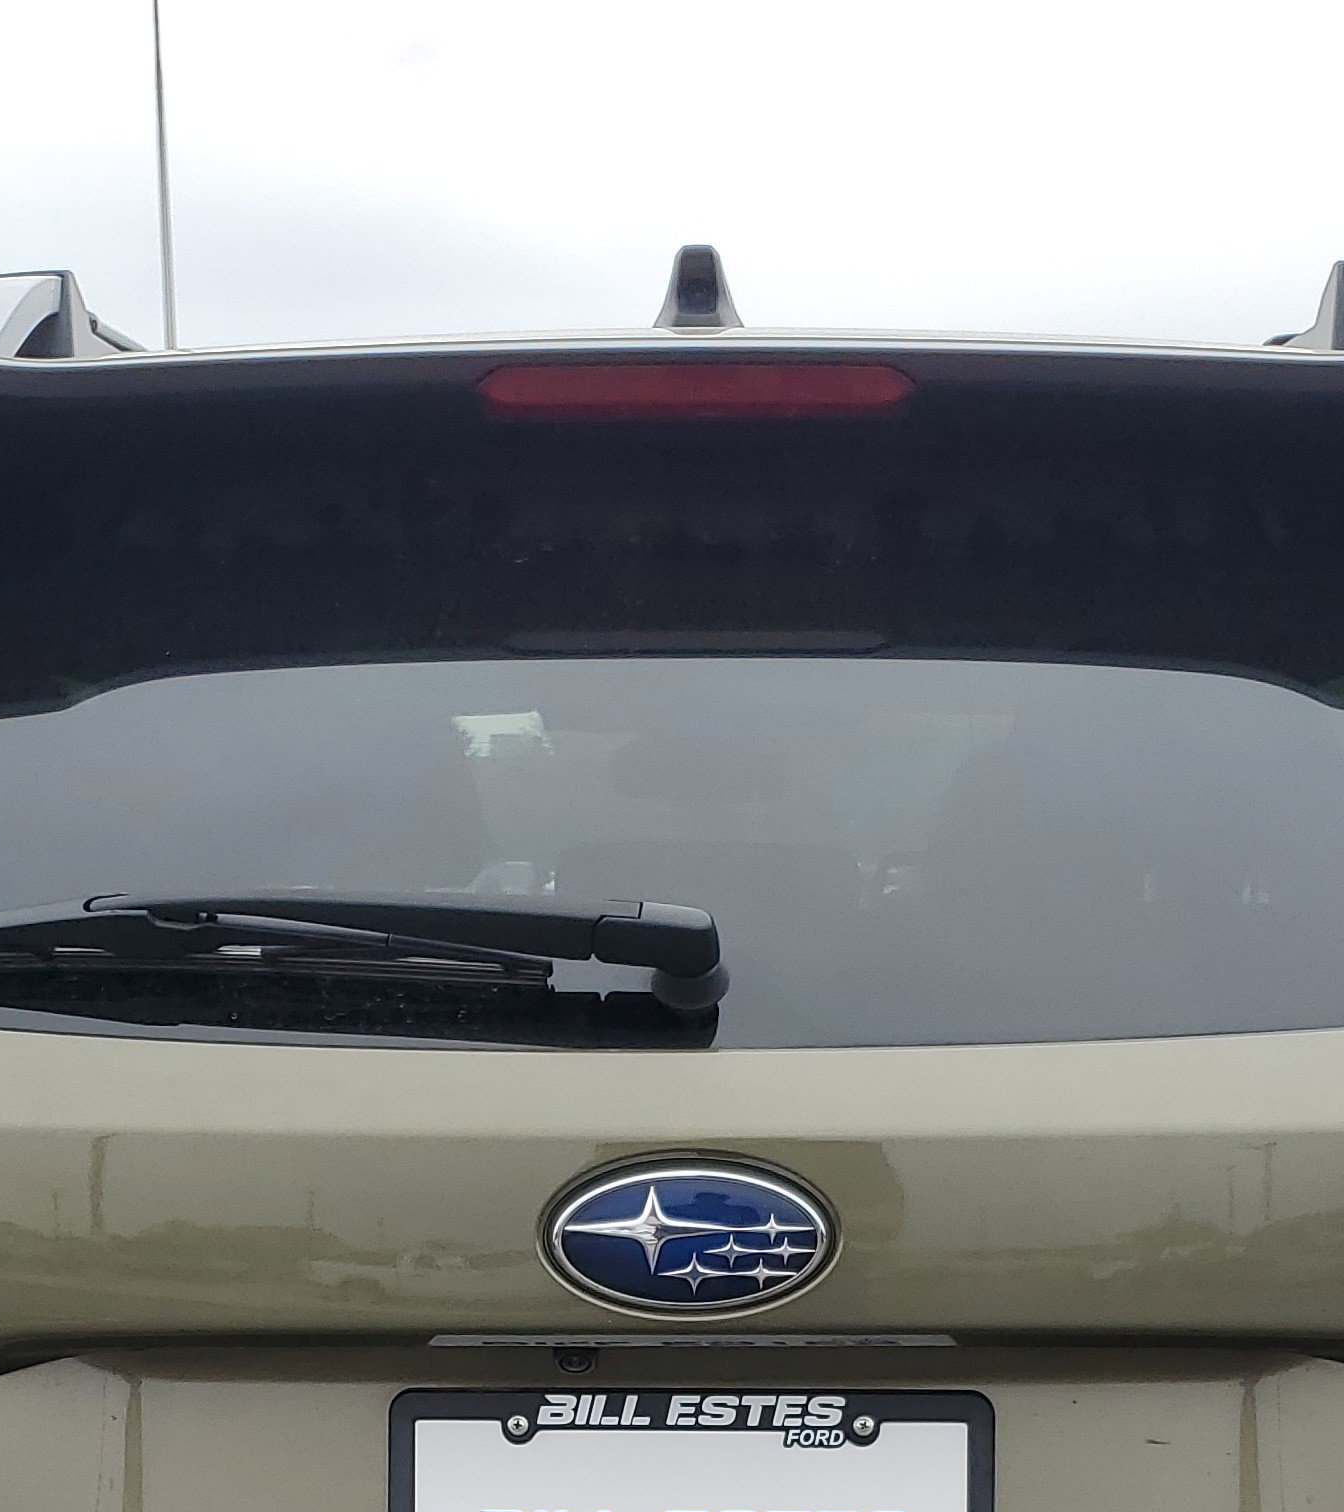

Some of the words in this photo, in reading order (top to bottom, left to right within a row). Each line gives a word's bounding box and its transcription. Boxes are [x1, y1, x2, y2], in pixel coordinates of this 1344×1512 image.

[537, 1395, 652, 1426] BILL
[665, 1395, 847, 1427] ESTES
[785, 1429, 845, 1447] FORD
